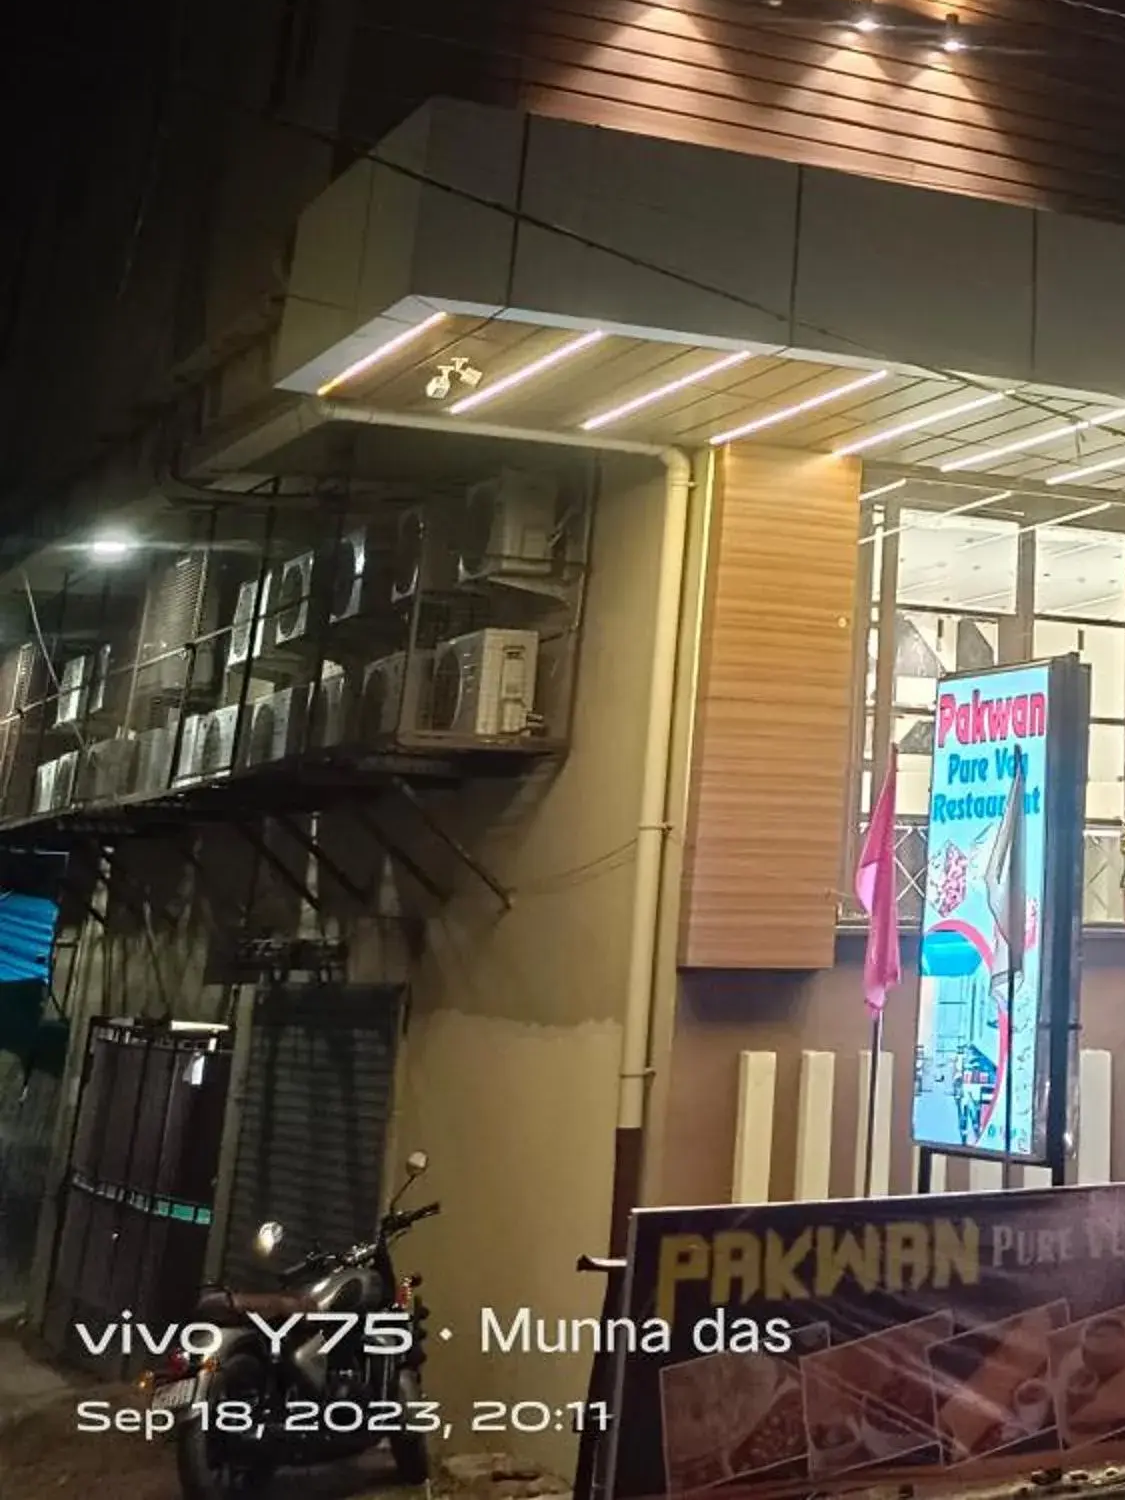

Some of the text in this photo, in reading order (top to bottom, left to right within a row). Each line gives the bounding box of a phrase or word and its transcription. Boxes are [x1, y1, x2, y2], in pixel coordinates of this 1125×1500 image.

[938, 689, 1047, 748] Pakwan
[947, 753, 988, 785] Pure
[933, 786, 1041, 825] Restaurnt
[655, 1217, 981, 1332] PAKWAN
[992, 1225, 1074, 1268] PURE
